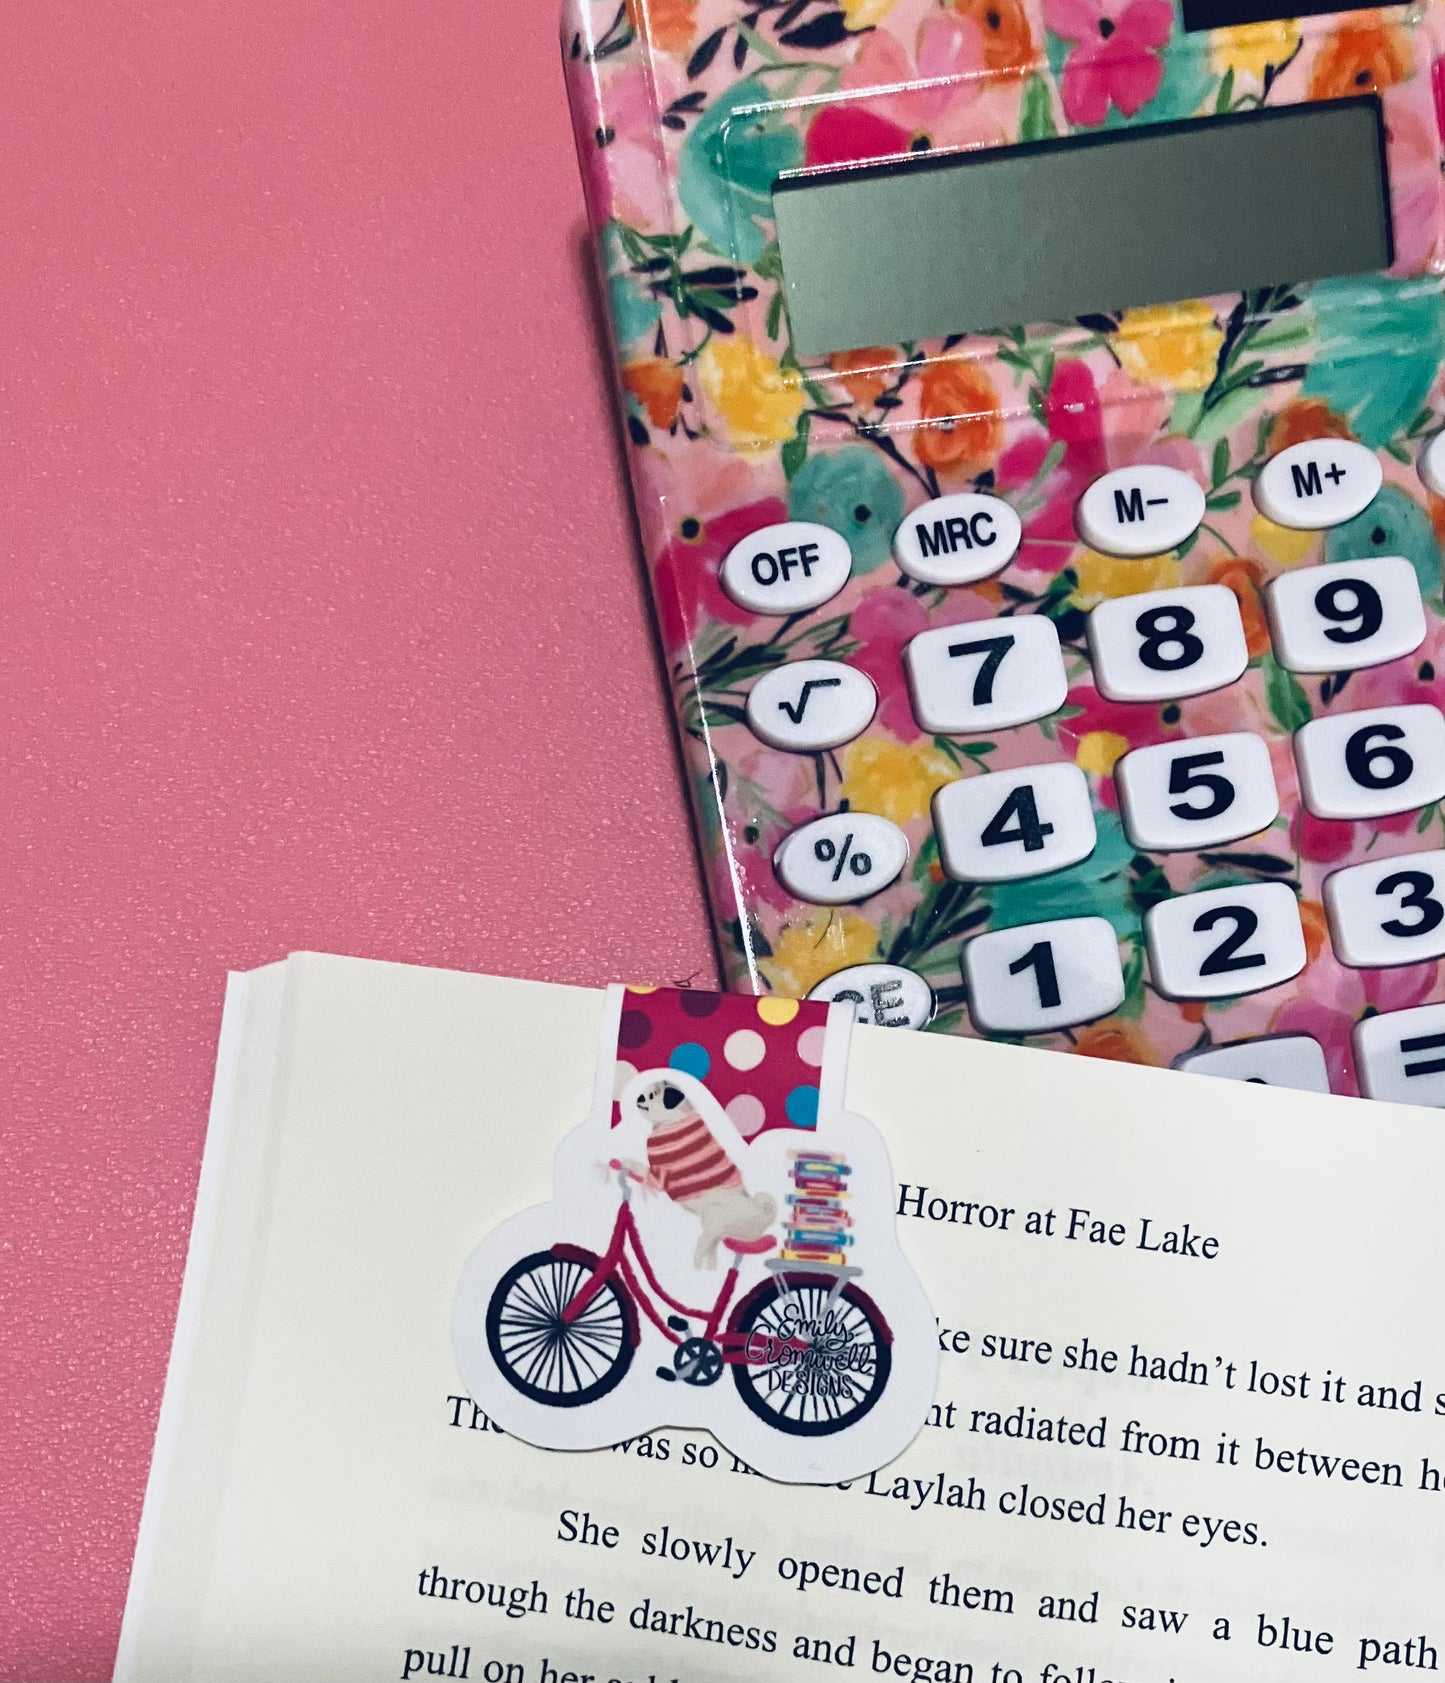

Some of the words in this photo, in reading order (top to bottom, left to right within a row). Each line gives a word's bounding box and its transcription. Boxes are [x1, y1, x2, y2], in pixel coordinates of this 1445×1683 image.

[1290, 462, 1347, 499] M+
[751, 542, 820, 585] OFF
[916, 511, 997, 558] MRC
[1135, 605, 1205, 672] 8
[1314, 578, 1384, 644] 9
[947, 634, 1016, 707] 7
[1168, 750, 1236, 821] 5
[1344, 723, 1414, 790] 6
[980, 784, 1055, 853] 4
[813, 833, 872, 882] %
[1375, 870, 1445, 938] 3
[1008, 940, 1062, 1009] 1
[1192, 905, 1267, 977] 2
[896, 1184, 1016, 1230] Horror
[1024, 1209, 1057, 1237] at
[1065, 1208, 1126, 1246] Fae
[1135, 1218, 1219, 1260] Lake
[777, 1303, 854, 1351] Emily
[768, 1369, 854, 1399] DESIGNS
[981, 1334, 1053, 1365] sure
[1062, 1338, 1118, 1374] she
[1247, 1360, 1311, 1399] lost
[1321, 1371, 1347, 1404] it
[1357, 1380, 1422, 1413] and
[968, 1405, 1107, 1449] radiated
[1119, 1420, 1200, 1461] from
[1216, 1431, 1241, 1466] it
[1255, 1437, 1403, 1487] between
[681, 1442, 719, 1469] so
[865, 1470, 986, 1511] Laylah
[998, 1483, 1106, 1526] closed
[1115, 1495, 1173, 1533] her
[1182, 1514, 1267, 1548] eyes.
[418, 1565, 548, 1619] through
[565, 1587, 615, 1624] the
[629, 1597, 777, 1653] darkness
[792, 1635, 856, 1667] and
[871, 1639, 973, 1683] began
[557, 1509, 620, 1549] She
[641, 1525, 757, 1580] slowly
[778, 1557, 905, 1598] opened
[929, 1572, 1014, 1614] them
[1038, 1591, 1099, 1624] and
[1121, 1605, 1189, 1634] saw
[1212, 1617, 1231, 1641] a
[1257, 1613, 1334, 1655] blue
[1356, 1635, 1438, 1671] path
[400, 1644, 471, 1681] pull
[483, 1660, 525, 1683] on
